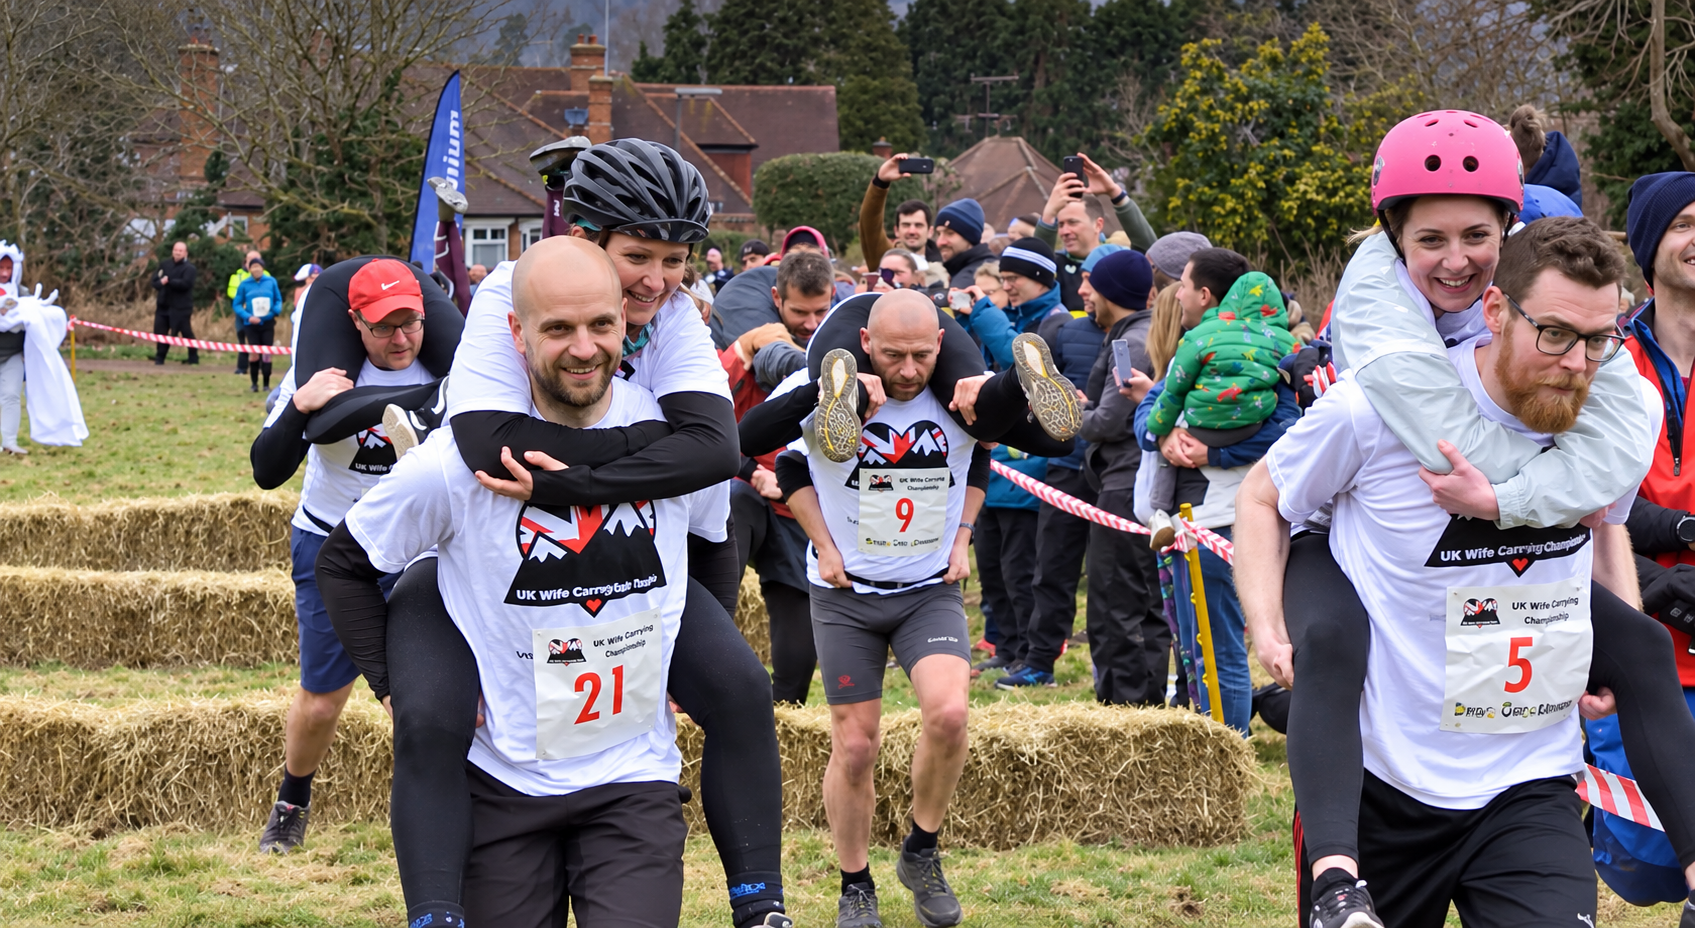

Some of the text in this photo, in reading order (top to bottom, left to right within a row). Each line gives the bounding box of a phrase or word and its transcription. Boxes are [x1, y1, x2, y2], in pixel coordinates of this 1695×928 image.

[355, 463, 367, 471] UK
[895, 497, 914, 533] 9
[1440, 549, 1462, 562] UK
[1465, 548, 1495, 561] Wife
[516, 589, 537, 601] UK
[539, 588, 570, 601] Wife
[1511, 601, 1527, 610] UK
[1530, 601, 1551, 611] Wife
[593, 624, 654, 648] UK Wife Carrying
[1504, 636, 1534, 694] 5
[573, 664, 624, 726] 21
